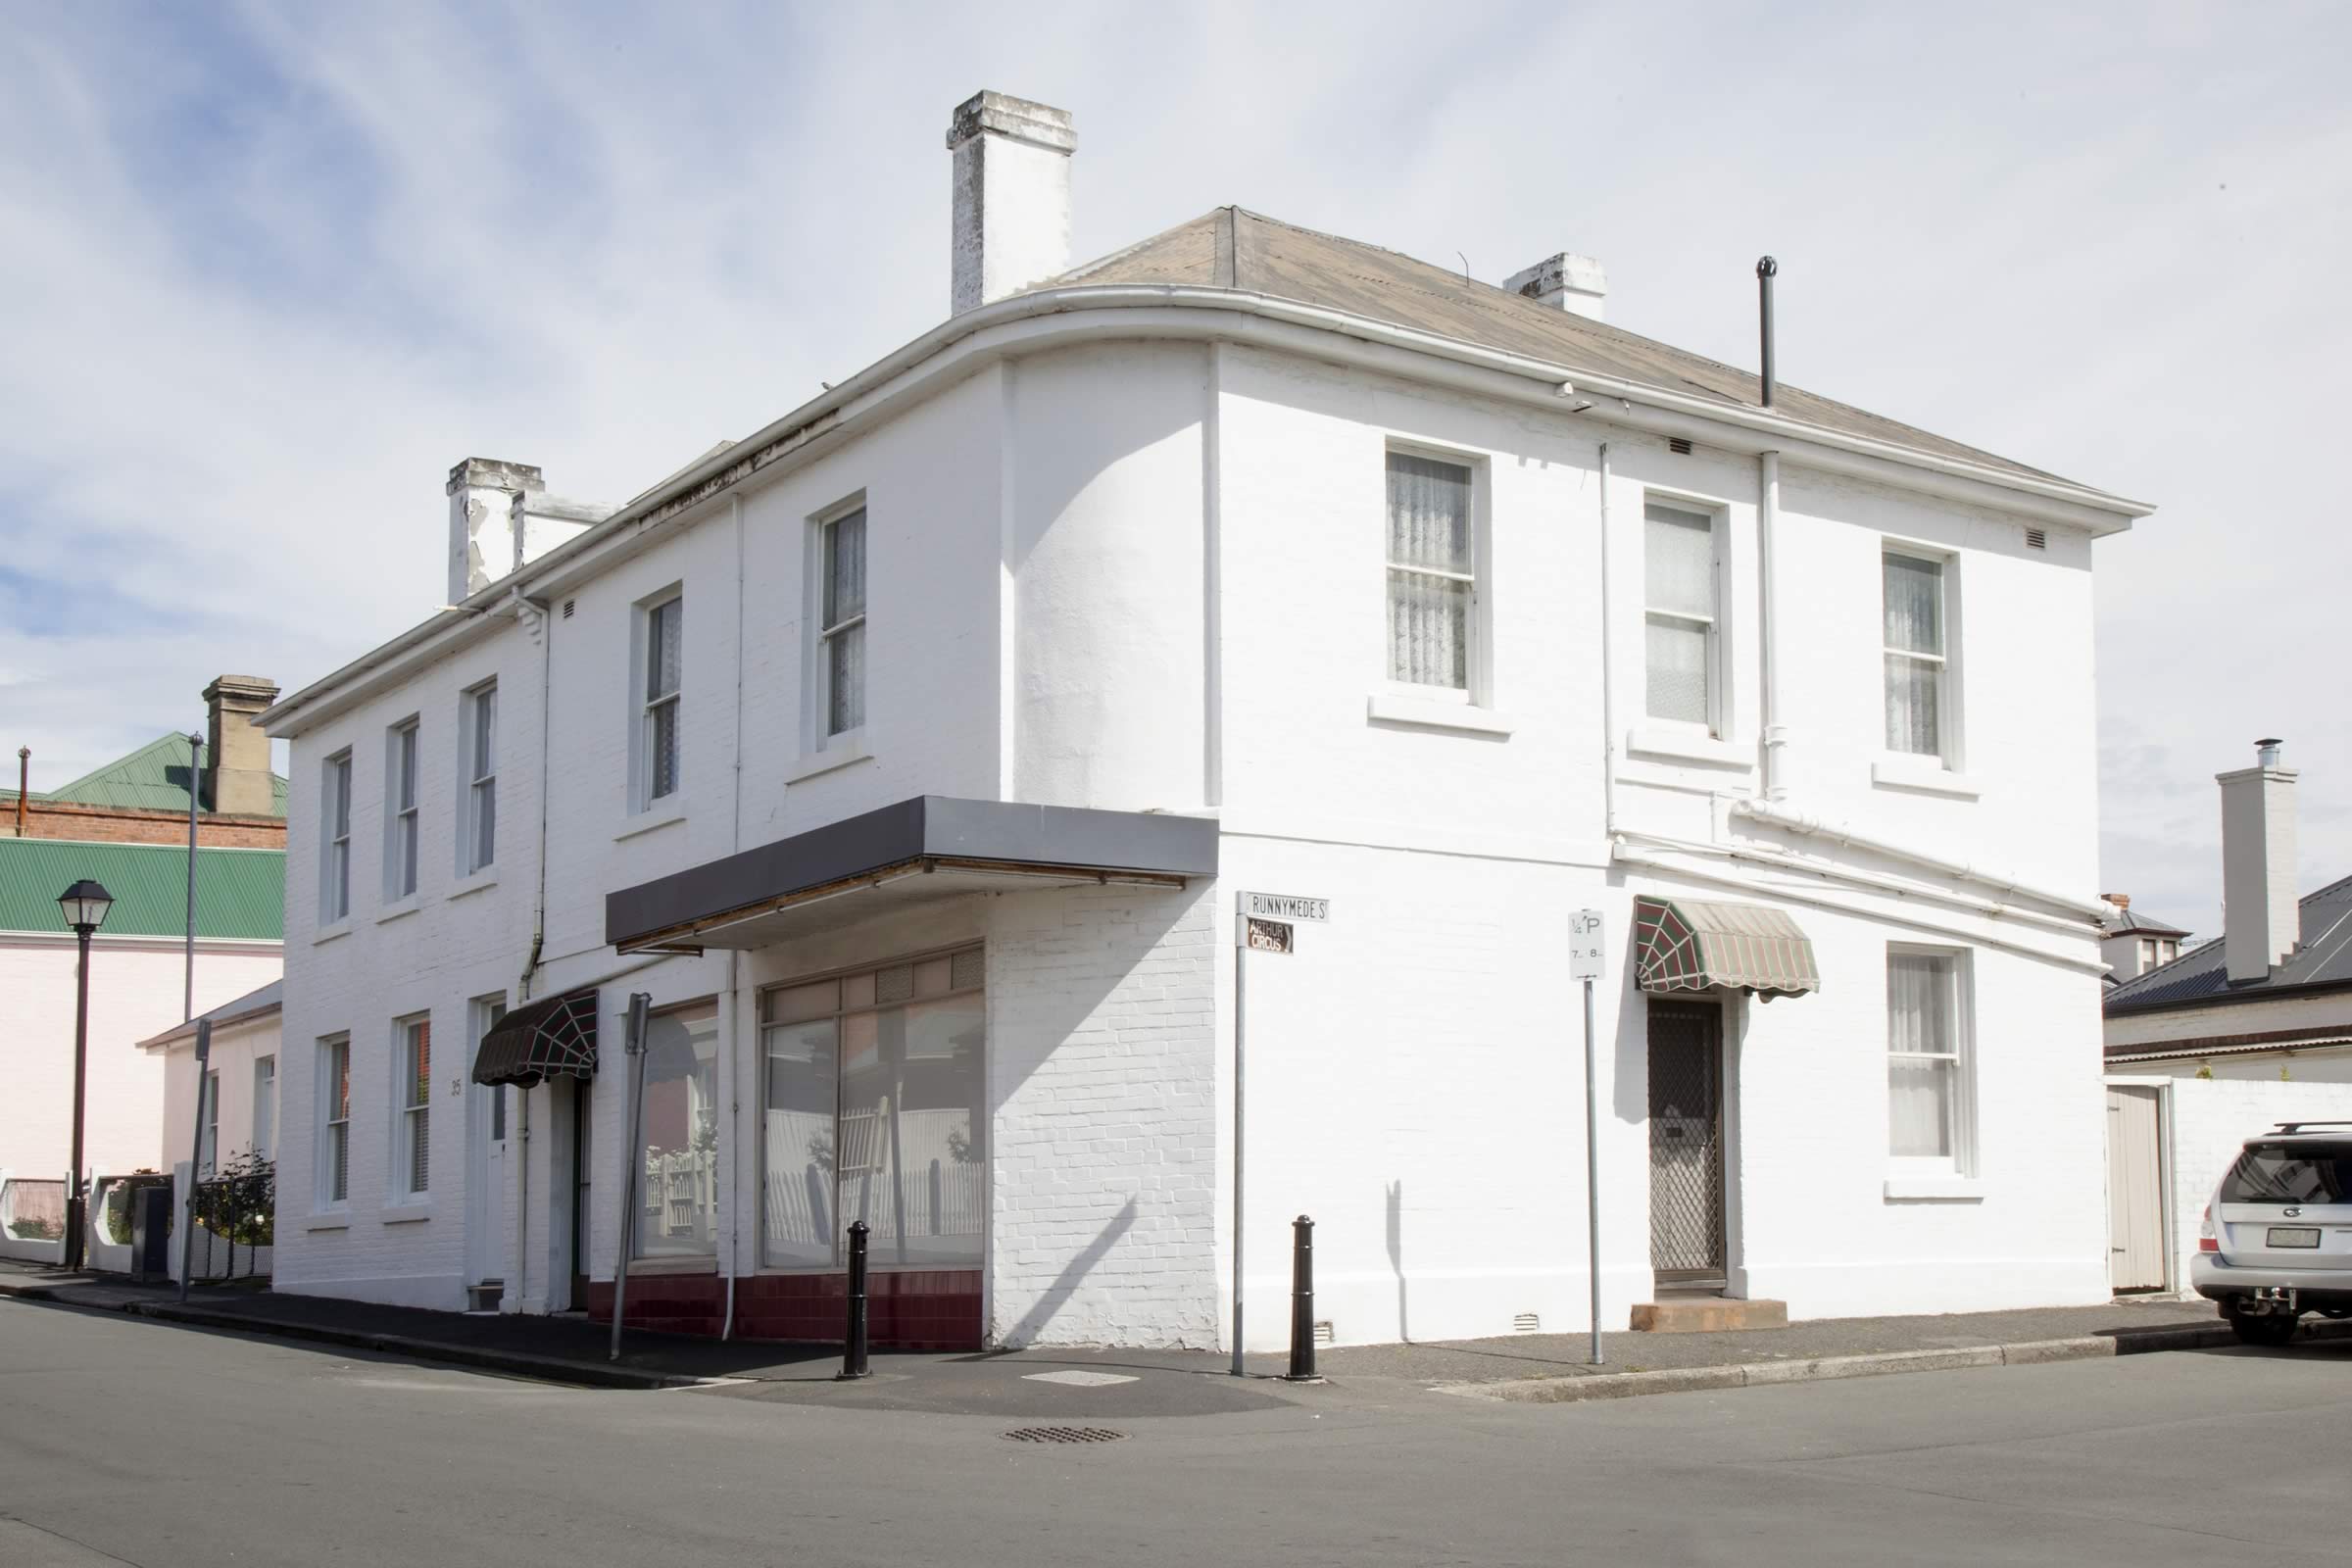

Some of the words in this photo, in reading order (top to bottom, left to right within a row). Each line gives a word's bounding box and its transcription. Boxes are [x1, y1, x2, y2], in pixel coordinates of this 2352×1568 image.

[1252, 896, 1315, 918] RUNNYMEDE
[1250, 920, 1284, 938] ARTHUR
[1251, 934, 1282, 952] CIRCUS
